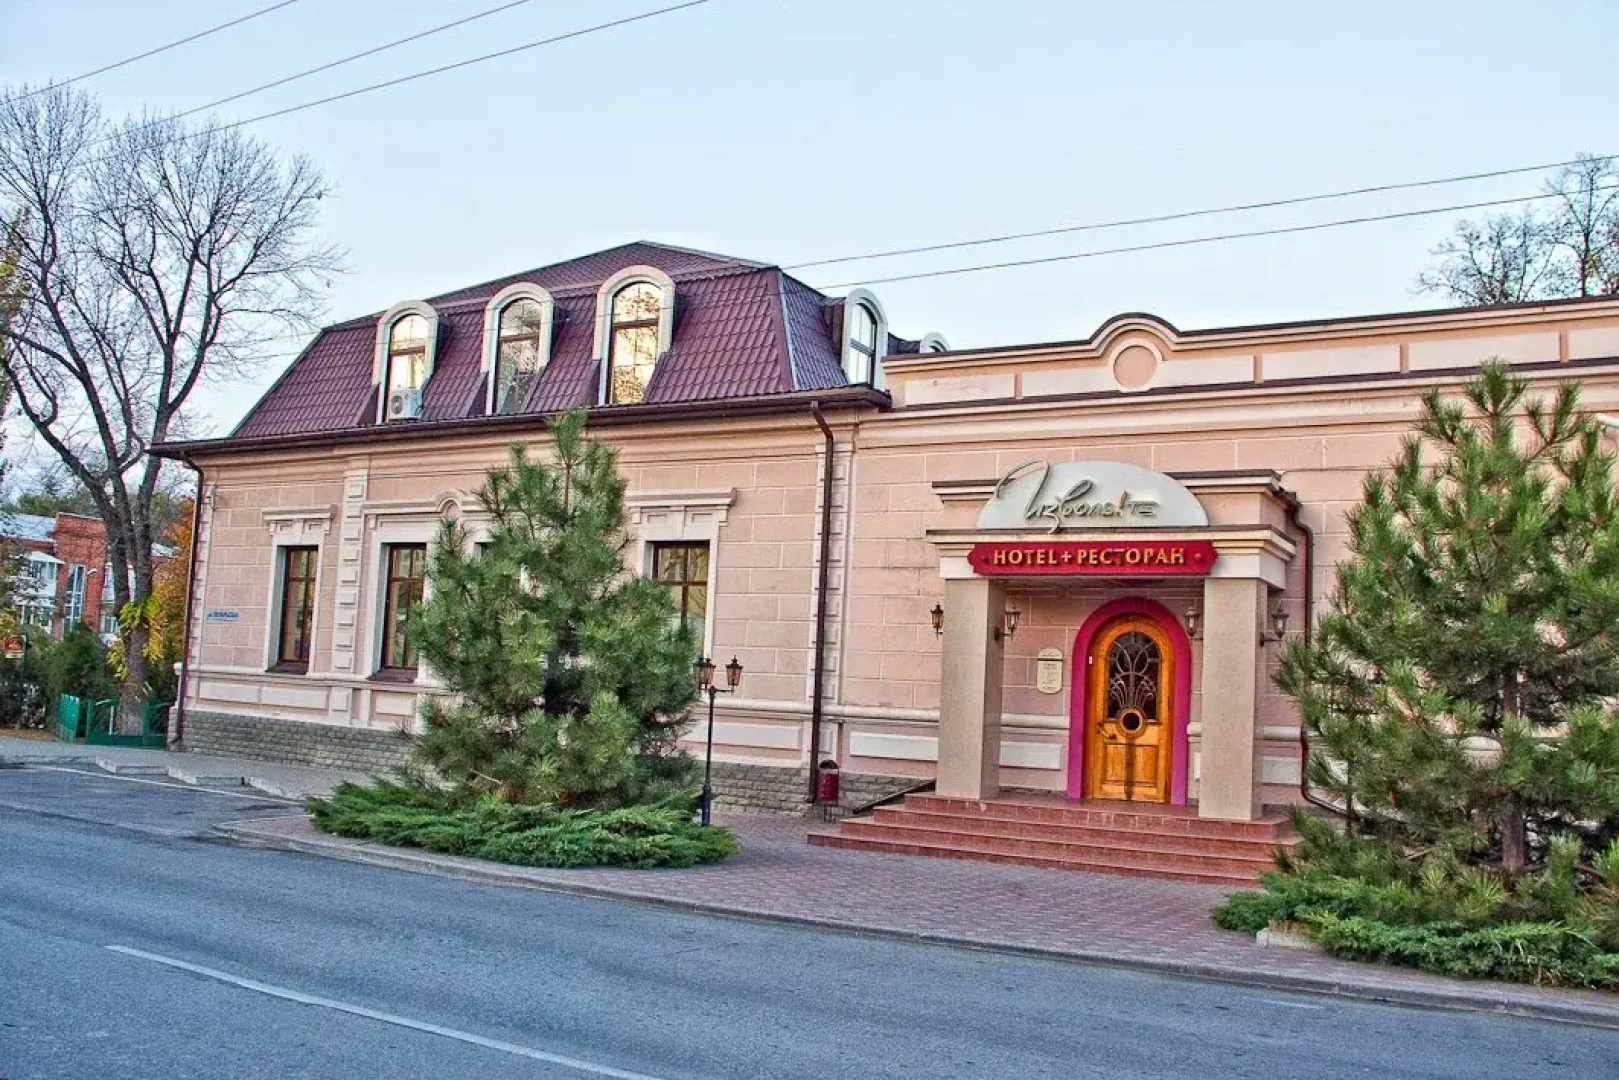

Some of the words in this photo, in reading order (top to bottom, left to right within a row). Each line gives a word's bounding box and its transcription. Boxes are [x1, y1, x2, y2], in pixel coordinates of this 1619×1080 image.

[993, 548, 1058, 565] HOTEL
[1061, 550, 1072, 563] +
[1077, 547, 1185, 565] РЕСТОРАН
